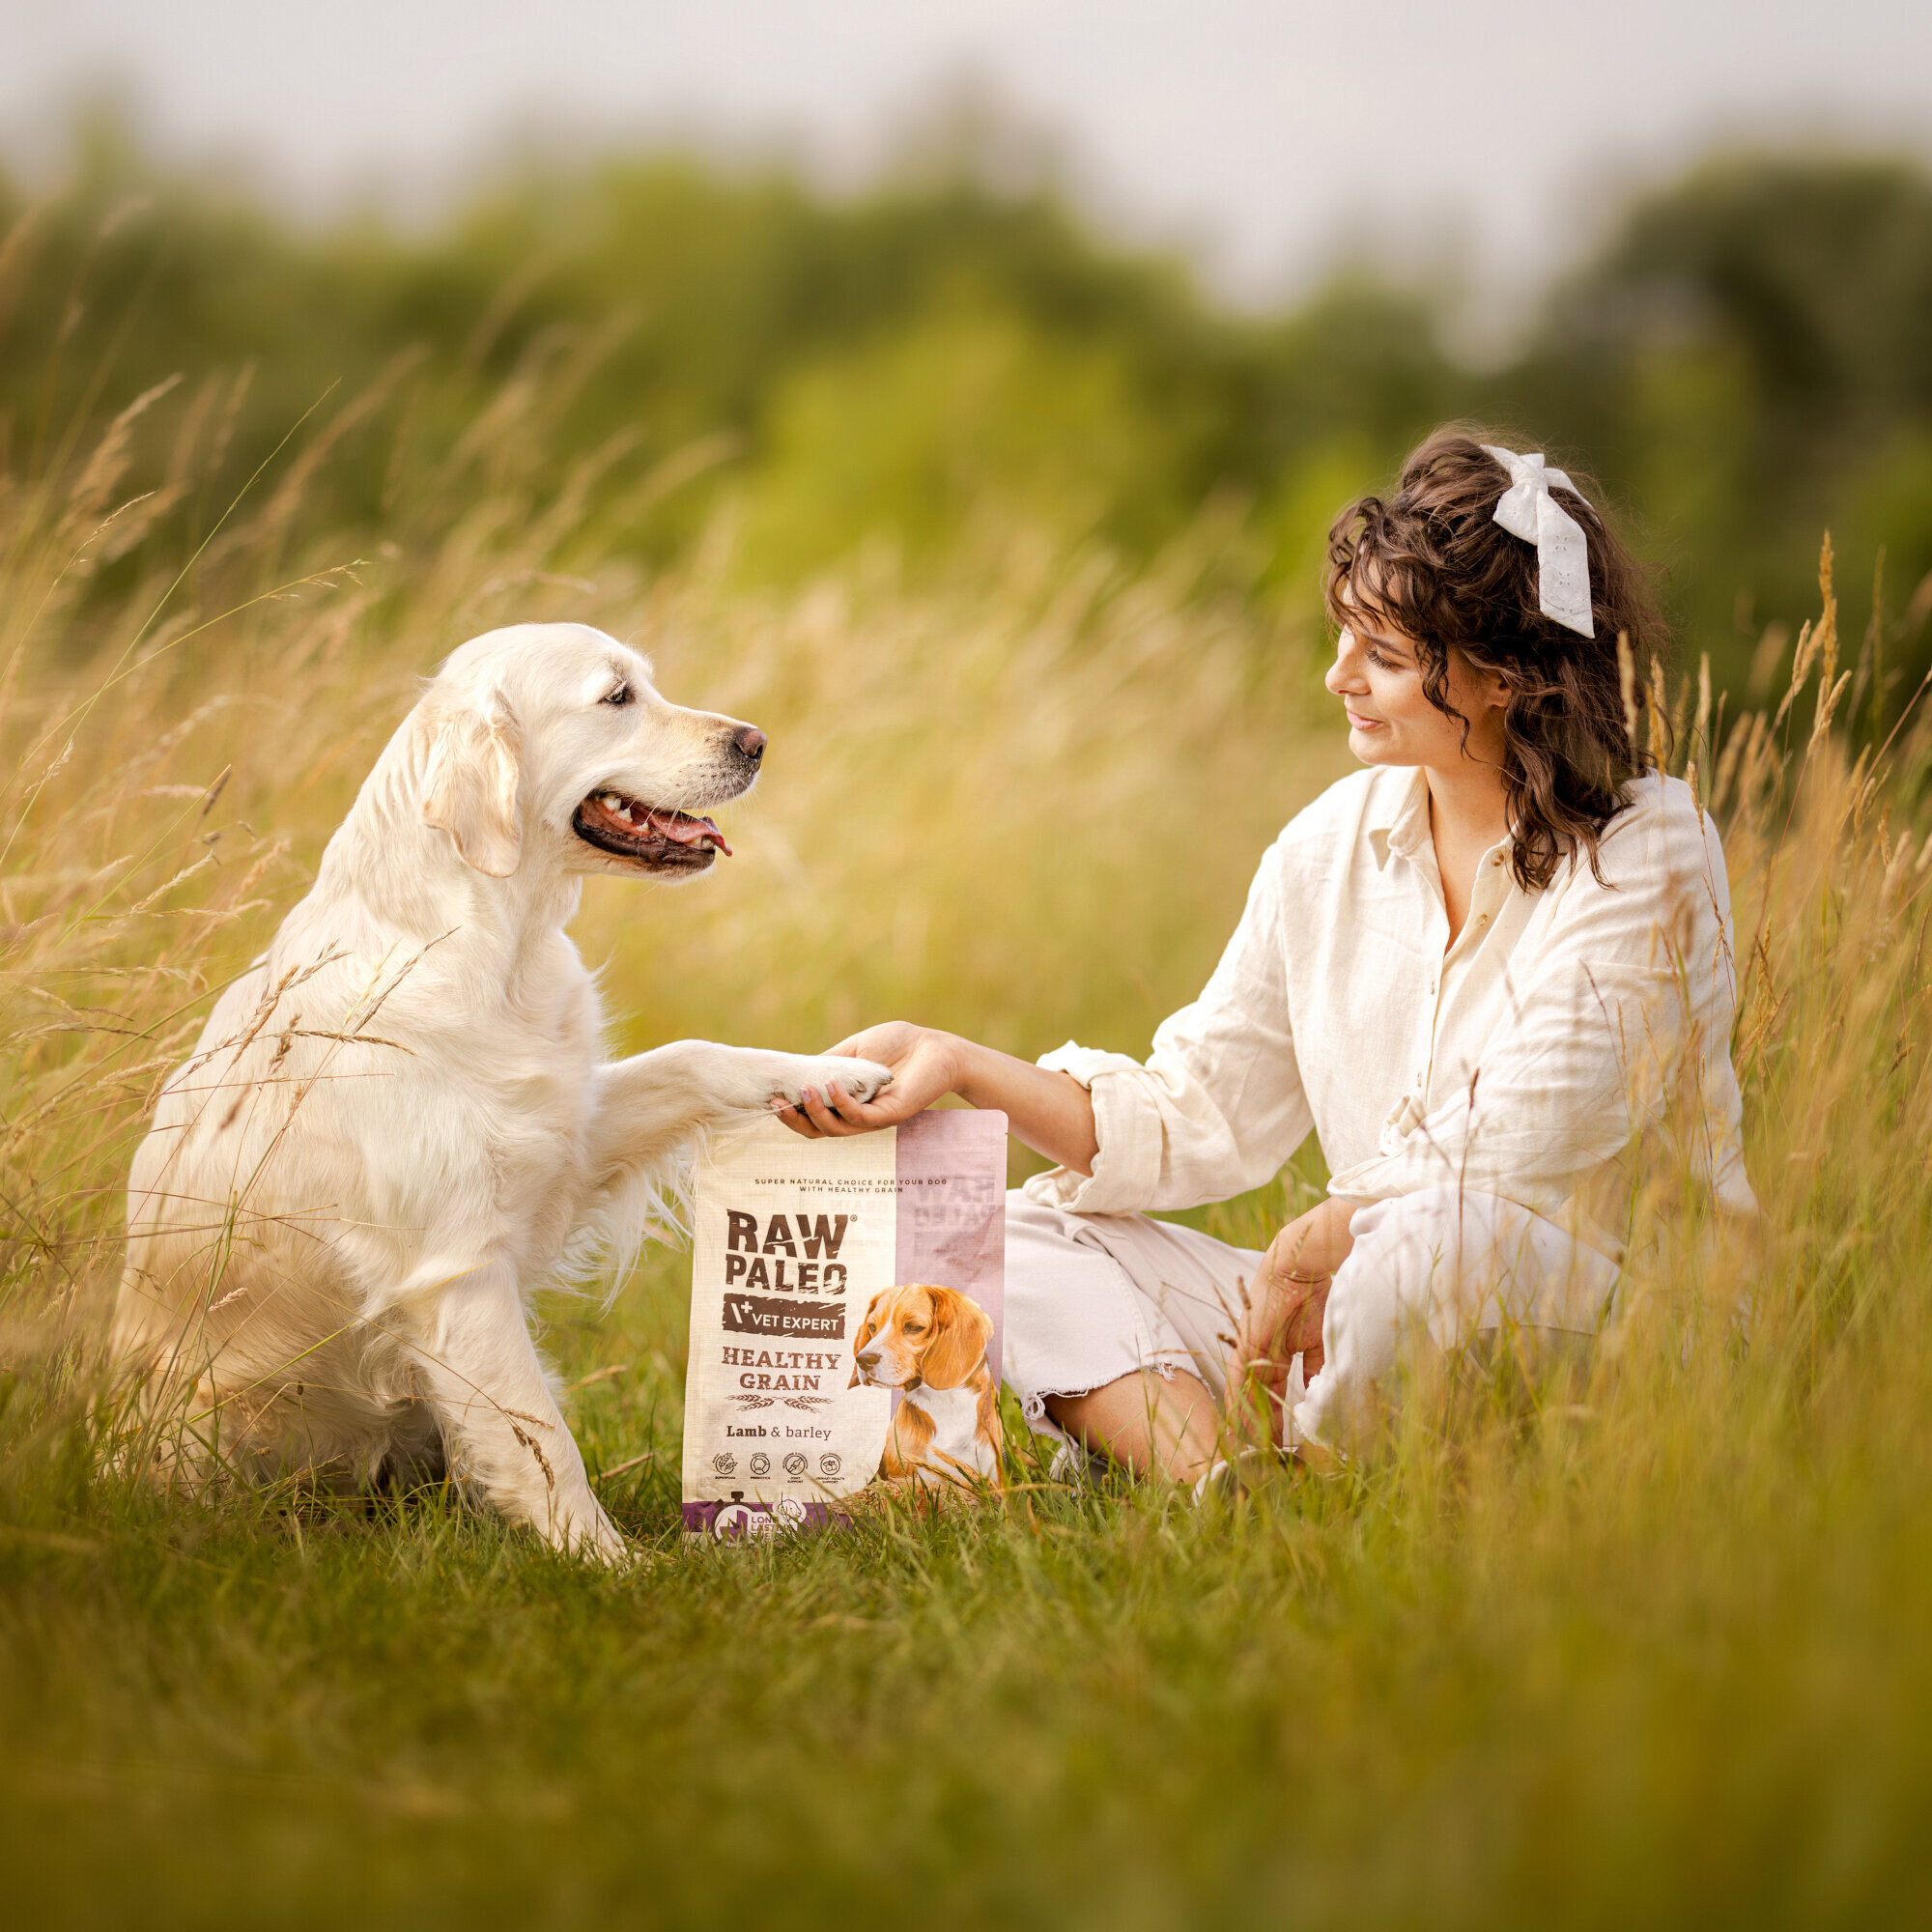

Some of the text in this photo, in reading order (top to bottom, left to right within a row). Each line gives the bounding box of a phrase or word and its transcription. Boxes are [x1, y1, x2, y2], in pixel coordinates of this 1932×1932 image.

[725, 1254, 847, 1294] PALEO
[752, 1313, 838, 1331] VET EXPERT
[721, 1346, 841, 1370] HEALTHY
[739, 1373, 821, 1390] GRAIN
[726, 1425, 833, 1440] Lamb & barley
